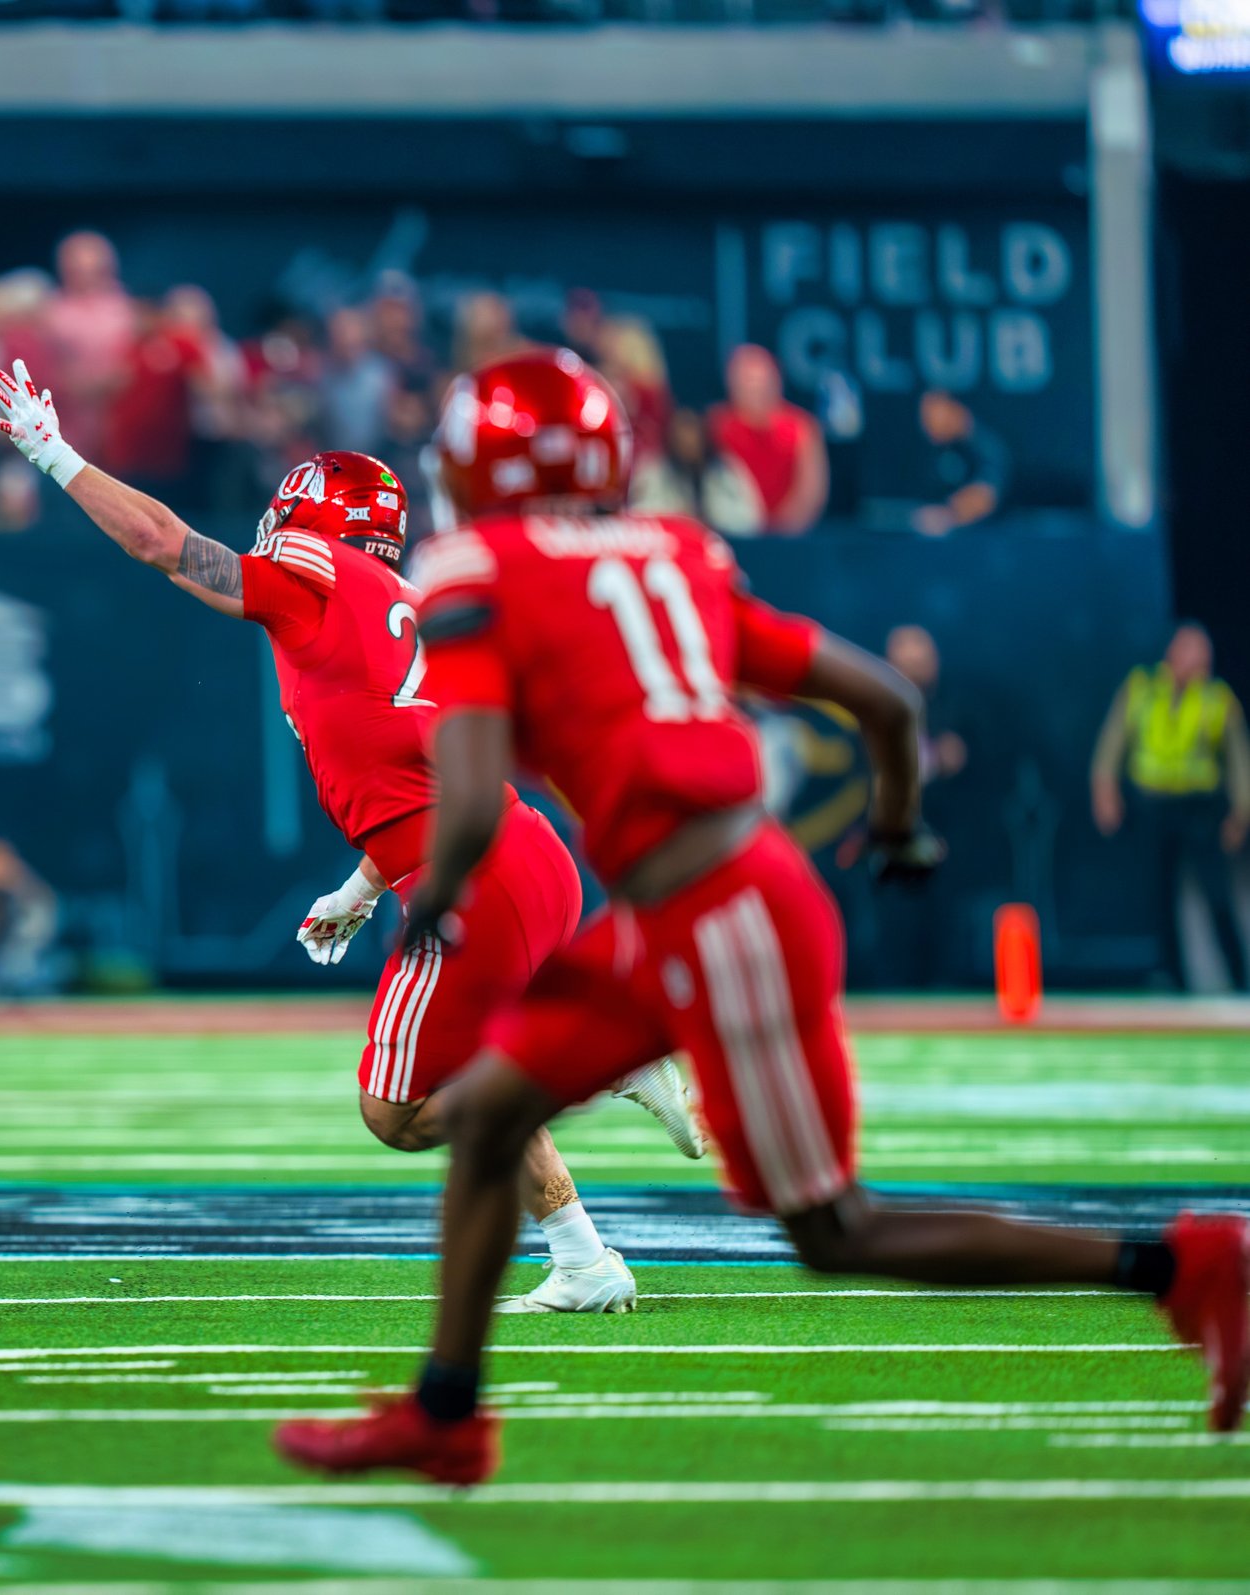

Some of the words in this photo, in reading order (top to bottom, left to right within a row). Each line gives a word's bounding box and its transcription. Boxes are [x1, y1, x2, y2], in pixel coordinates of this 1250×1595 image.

[762, 221, 1066, 304] FIELD
[780, 307, 1053, 391] CLUB
[345, 507, 371, 522] XII
[365, 541, 401, 561] UTES
[587, 556, 727, 723] 11
